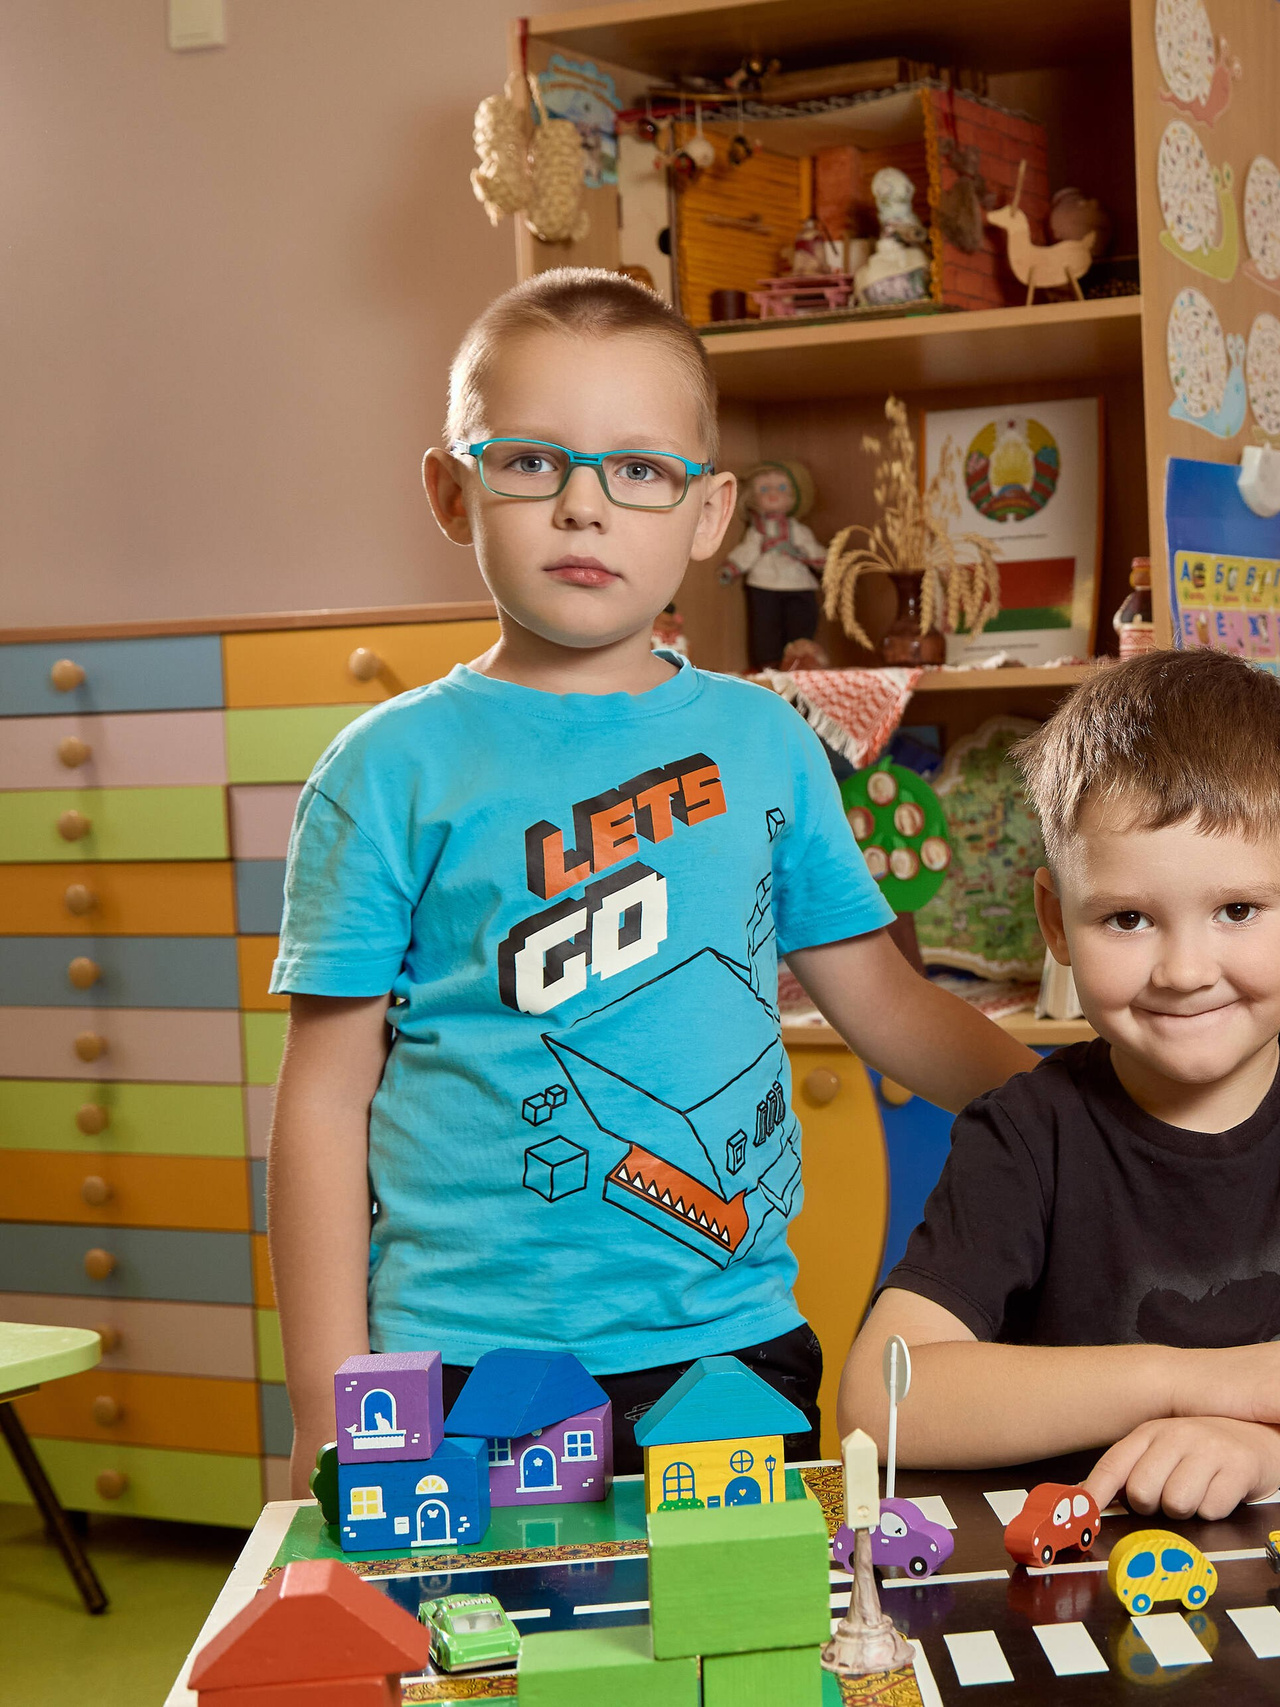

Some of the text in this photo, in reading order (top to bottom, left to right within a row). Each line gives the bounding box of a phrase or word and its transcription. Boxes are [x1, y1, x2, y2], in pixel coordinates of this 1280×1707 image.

[1180, 560, 1191, 581] А
[1215, 563, 1224, 584] Б
[525, 752, 727, 900] LETS
[498, 861, 667, 1015] GO
